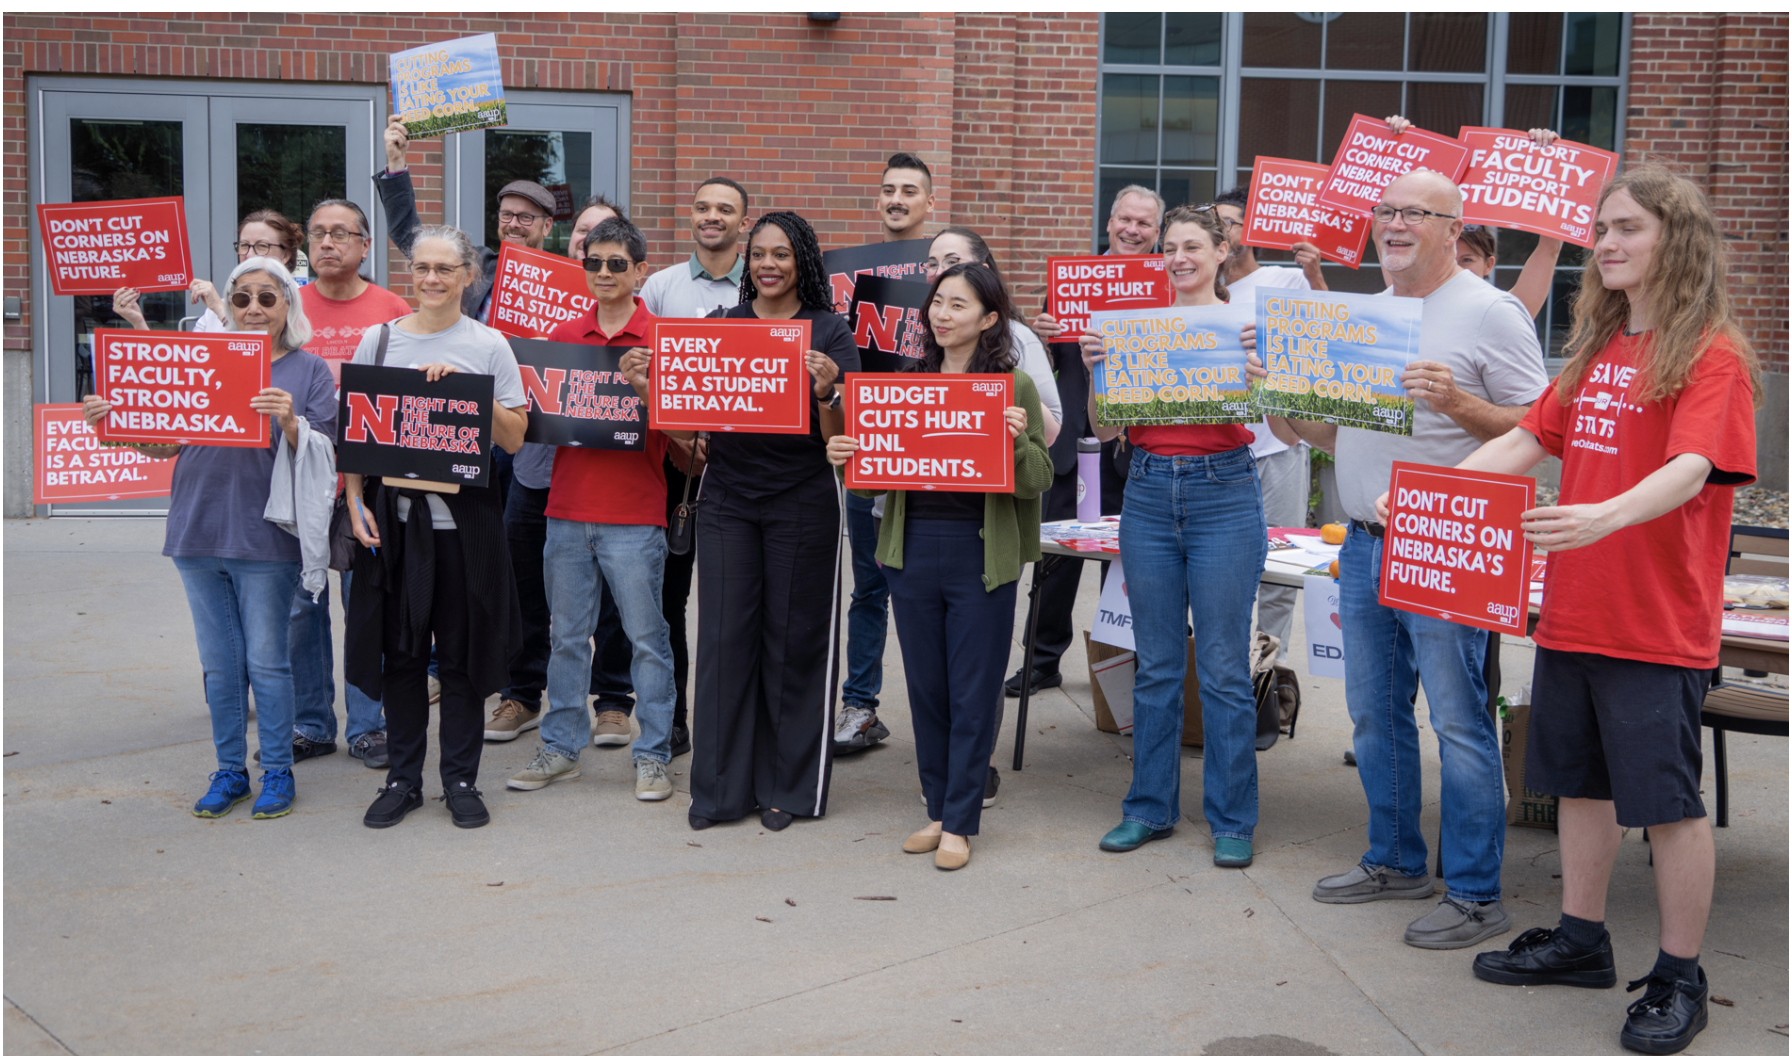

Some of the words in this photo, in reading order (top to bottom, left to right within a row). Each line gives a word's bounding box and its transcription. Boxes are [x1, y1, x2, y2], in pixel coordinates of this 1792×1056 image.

[396, 49, 449, 72] CUTTING
[397, 58, 471, 85] PROGRAMS
[398, 84, 409, 98] IS
[410, 78, 438, 96] LIKE
[399, 90, 446, 111] EATING
[447, 83, 490, 102] YOUR
[400, 107, 431, 125] SEED
[433, 99, 480, 118] CORN.
[477, 108, 500, 121] aaup
[1351, 131, 1398, 154] DON'T
[1396, 142, 1430, 162] CUT
[1492, 136, 1580, 163] SUPPORT
[1345, 148, 1413, 175] CORNERS
[1469, 148, 1595, 187] FACULTY
[1261, 172, 1314, 190] DON'T
[1336, 162, 1398, 187] NEBRAS
[1482, 170, 1570, 197] SUPPORT
[1258, 187, 1334, 211] CORNE
[1329, 178, 1382, 203] FUTURE.
[1457, 183, 1592, 225] STUDENTS
[50, 218, 103, 233] DON'T
[107, 216, 143, 231] CUT
[1253, 217, 1318, 238] FUTURE.
[1256, 202, 1354, 233] NEBRASKA'S
[53, 232, 136, 248] CORNERS
[140, 230, 170, 244] ON
[1560, 222, 1586, 238] aaup
[56, 246, 166, 264] NEBRASKA'S
[1336, 246, 1356, 261] aaup
[59, 265, 126, 280] FUTURE.
[157, 272, 185, 284] aaup
[504, 259, 553, 283] EVERY
[876, 262, 916, 276] FIGHT
[1057, 264, 1126, 280] BUDGET
[502, 275, 569, 304] FACULTY
[570, 294, 598, 312] CU
[1057, 282, 1103, 298] CUTS
[1107, 281, 1155, 296] HURT
[500, 290, 512, 306] IS
[514, 296, 524, 310] A
[528, 300, 584, 322] STUDE
[1058, 300, 1092, 314] UNL
[1266, 298, 1350, 322] CUTTING
[497, 306, 558, 334] BETRAY
[852, 300, 904, 354] N
[1101, 316, 1186, 337] CUTTING
[770, 328, 800, 342] aaup
[1266, 316, 1377, 346] PROGRAMS
[108, 342, 210, 364] STRONG
[228, 342, 260, 356] aaup
[660, 337, 722, 354] EVERY
[1102, 332, 1218, 354] PROGRAMS
[1266, 335, 1284, 354] IS
[1288, 337, 1328, 359] LIKE
[660, 356, 746, 374] FACULTY
[750, 358, 789, 374] CUT
[1104, 354, 1122, 370] IS
[1126, 352, 1168, 370] LIKE
[1266, 354, 1336, 379] EATING
[1338, 361, 1396, 388] YOUR
[108, 365, 222, 390] FACULTY,
[569, 368, 612, 384] FIGHT
[612, 371, 631, 386] FO
[660, 375, 678, 391] IS
[682, 375, 698, 392] A
[701, 376, 788, 394] STUDENT
[1105, 369, 1178, 388] EATING
[1180, 366, 1242, 385] YOUR
[1588, 362, 1638, 389] SAVE
[109, 388, 210, 409] STRONG
[568, 381, 596, 395] THE
[859, 386, 949, 405] BUDGET
[972, 382, 1003, 397] aaup
[1107, 386, 1155, 404] SEED
[1158, 384, 1225, 403] CORN.
[1264, 372, 1310, 395] SEED
[1314, 378, 1378, 405] CORN.
[402, 394, 446, 412] FIGHT
[448, 399, 480, 416] FOR
[566, 393, 620, 409] FUTURE
[620, 396, 640, 410] OF
[661, 394, 764, 412] BETRAYAL.
[110, 410, 246, 434] NEBRASKA.
[401, 408, 430, 424] THE
[564, 405, 640, 422] NEBRASKA
[858, 409, 918, 428] CUTS
[924, 410, 986, 430] HURT
[1372, 406, 1404, 425] aaup
[46, 420, 96, 435] EVER
[401, 422, 456, 439] FUTURE
[458, 426, 480, 440] OF
[1574, 414, 1616, 439] STATS
[400, 434, 481, 455] NEBRASKA
[614, 431, 639, 445] aaup
[859, 433, 905, 452] UNL
[46, 454, 64, 468] IS
[68, 454, 84, 468] A
[88, 451, 168, 468] STUDE
[859, 456, 982, 478] STUDENTS.
[46, 467, 148, 486] BETRAYAL.
[452, 464, 480, 480] aaup
[1397, 487, 1448, 514] DON'T
[1450, 495, 1488, 520] CUT
[1394, 512, 1476, 545] CORNERS
[1480, 526, 1512, 551] ON
[1392, 536, 1504, 576] NEBRASKA'S
[1390, 560, 1456, 594] FUTURE.
[1100, 609, 1133, 630] TMF
[1486, 602, 1518, 624] aaup
[1312, 643, 1345, 660] ED
